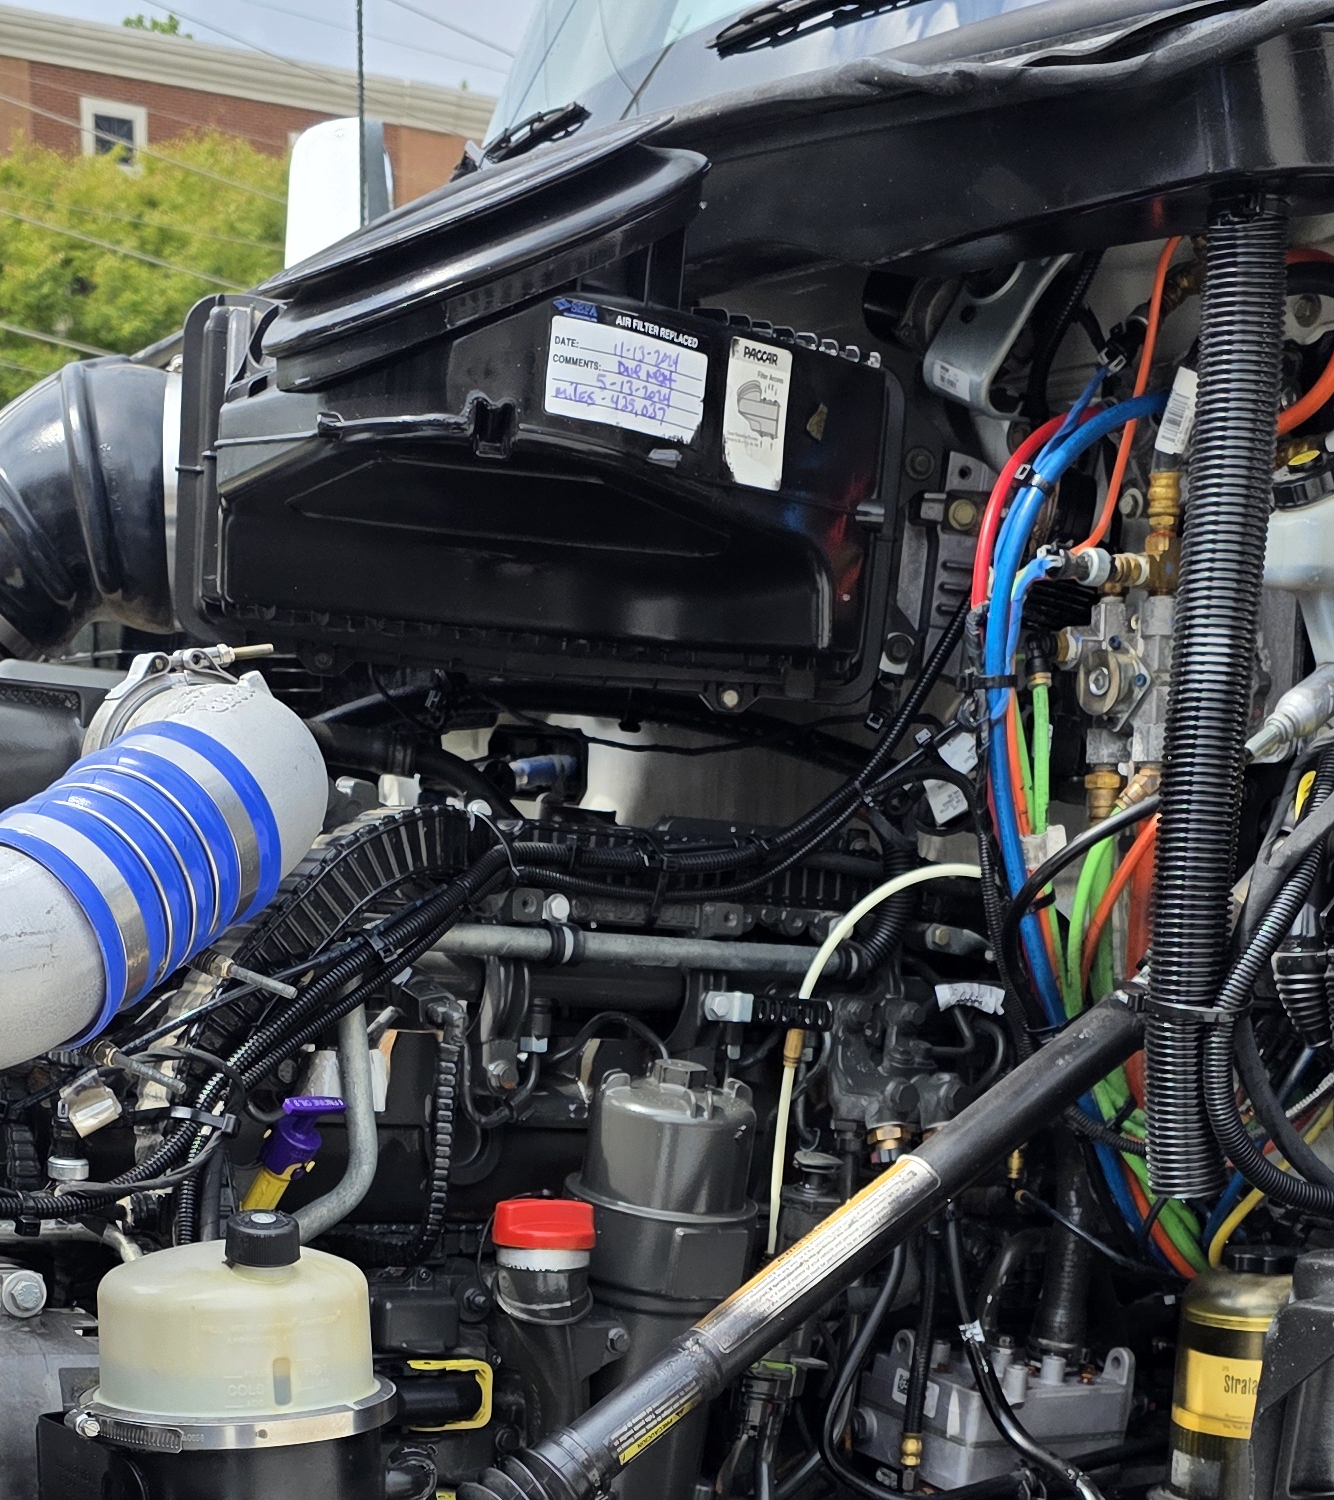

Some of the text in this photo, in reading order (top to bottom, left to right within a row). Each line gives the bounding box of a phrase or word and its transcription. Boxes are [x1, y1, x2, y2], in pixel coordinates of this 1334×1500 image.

[616, 315, 698, 348] AIR FILTER REPLACED
[554, 335, 580, 348] DATE:
[553, 354, 602, 371] COMMENTS:
[743, 346, 778, 366] PACCAR
[227, 1383, 264, 1397] COLD
